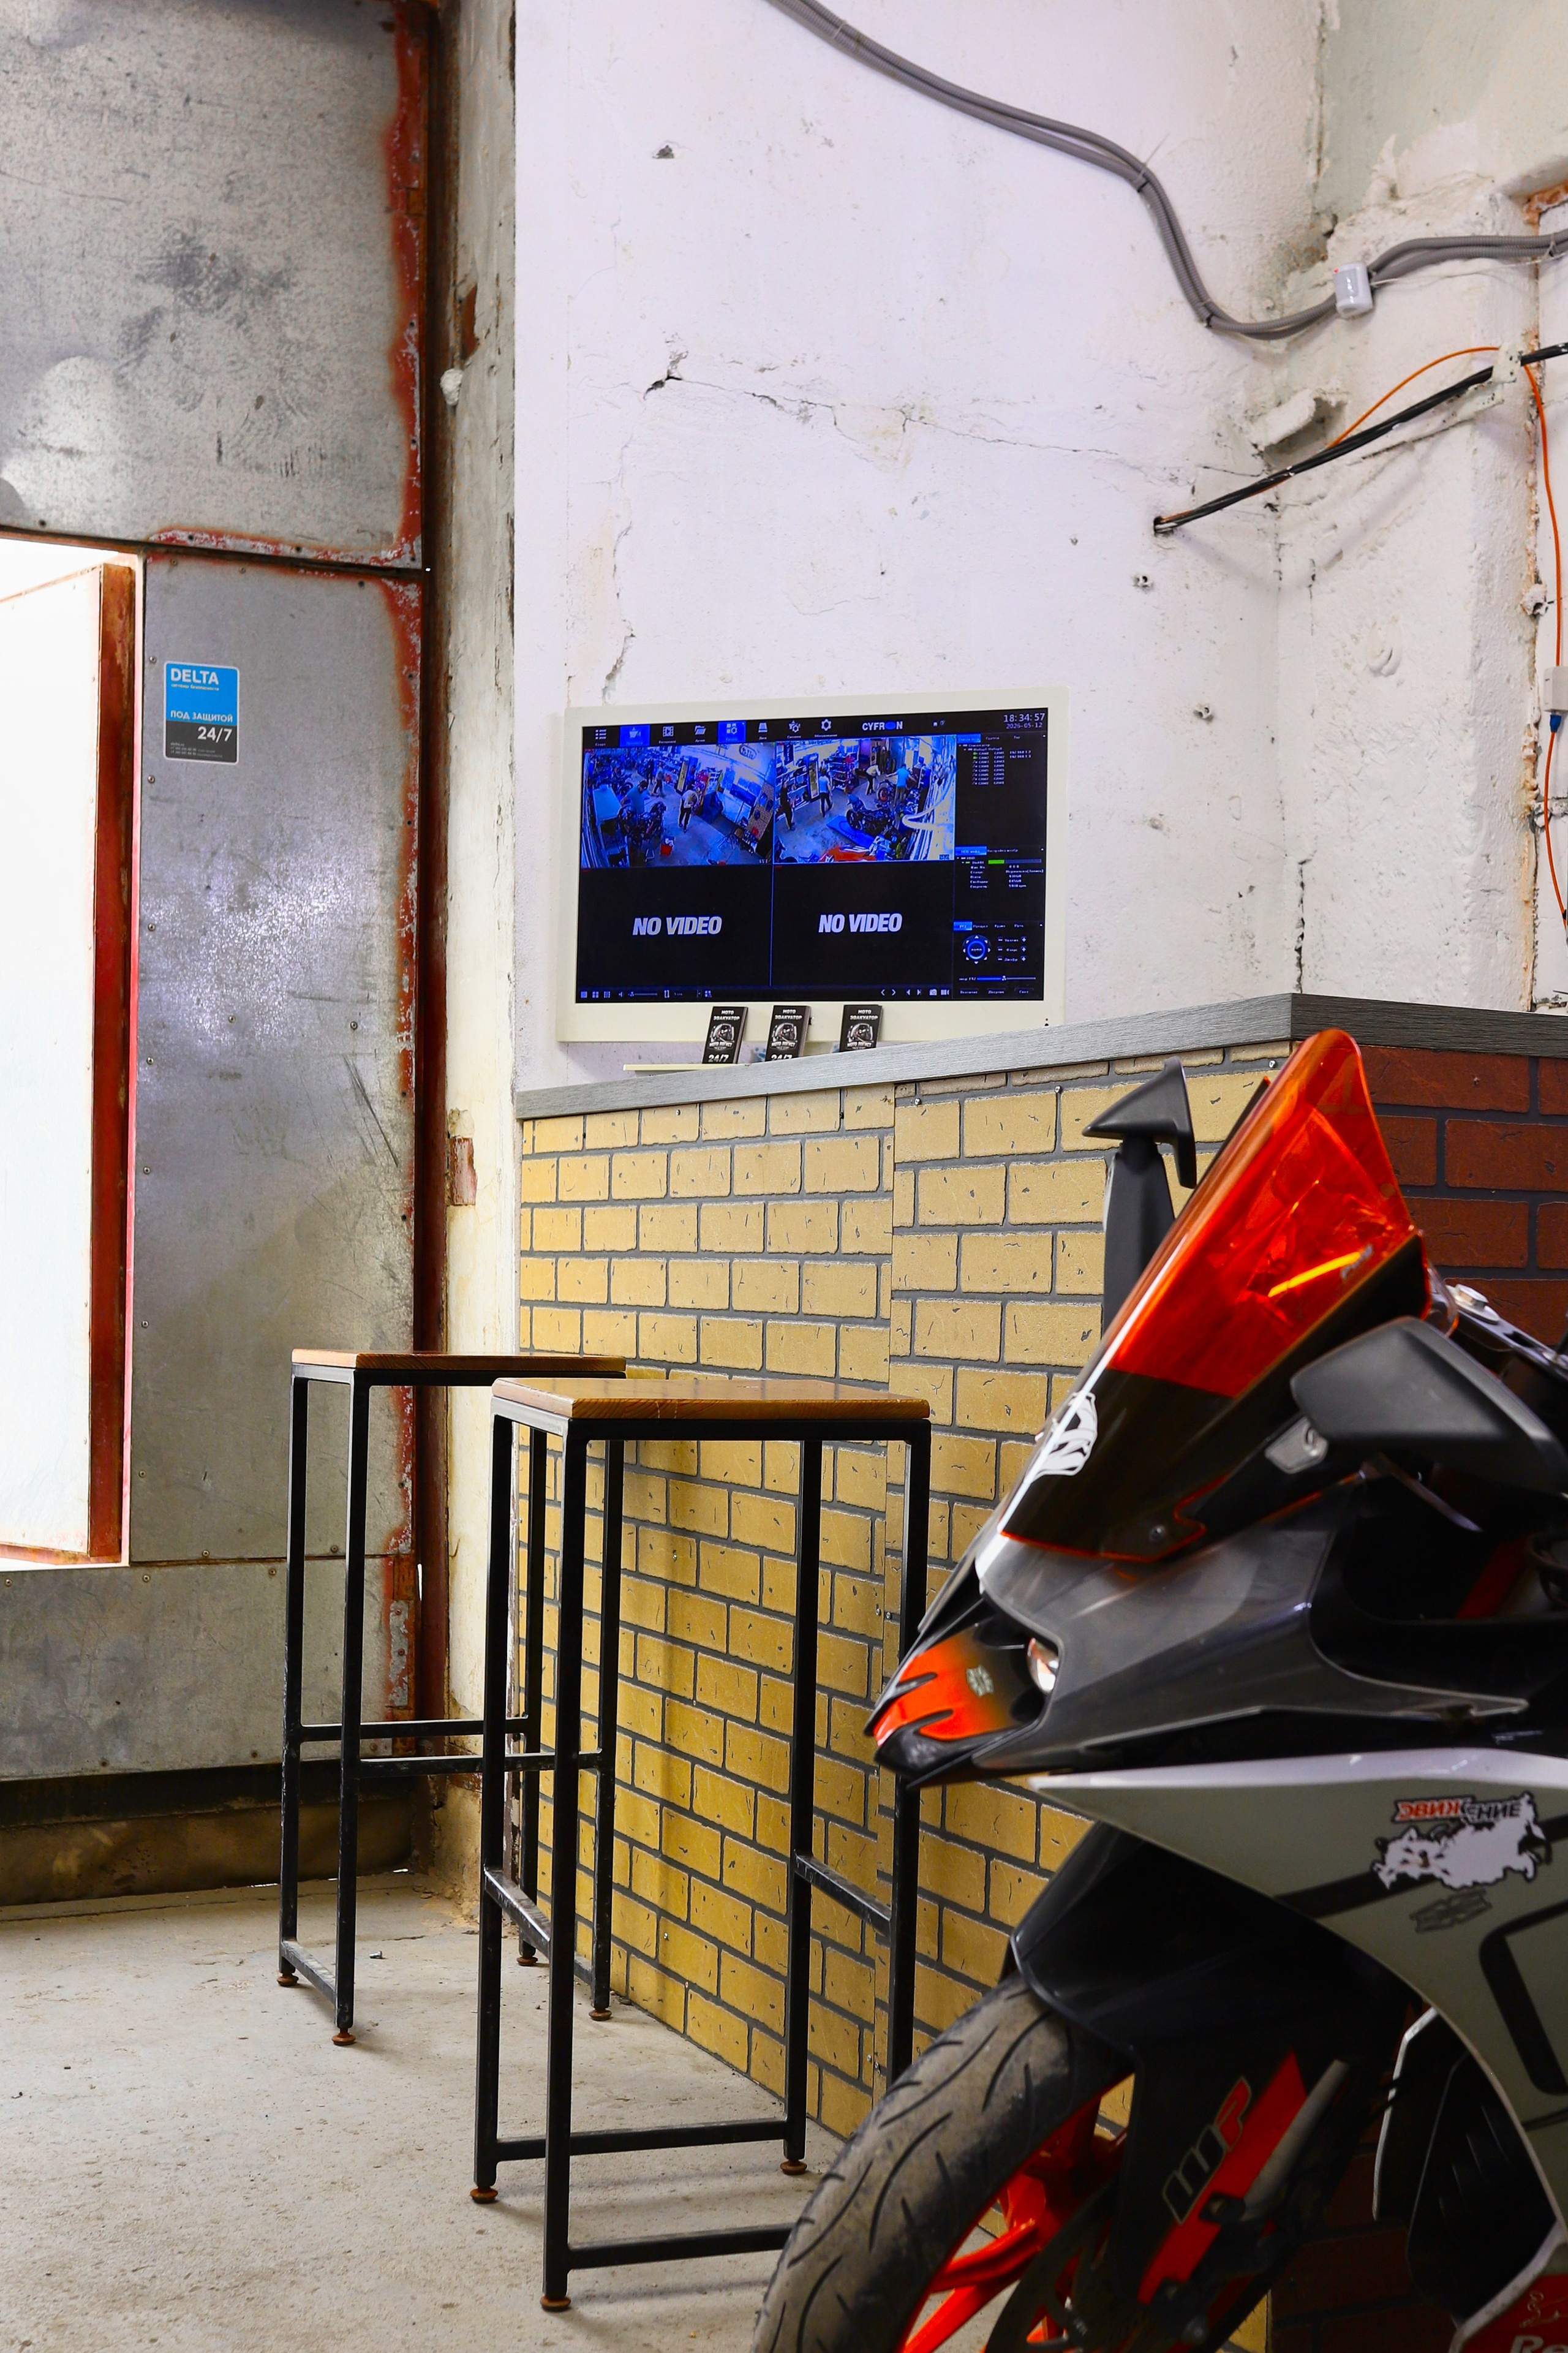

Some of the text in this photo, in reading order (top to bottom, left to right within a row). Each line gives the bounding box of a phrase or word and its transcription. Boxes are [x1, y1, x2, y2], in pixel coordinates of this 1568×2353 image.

[170, 668, 219, 685] DELTA
[170, 710, 233, 723] ПОД ЗАЩИТОЙ
[197, 726, 233, 742] 24/7
[633, 916, 722, 935] NO VIDEO
[818, 913, 903, 932] NO VIDEO
[708, 1054, 729, 1062] 24/7
